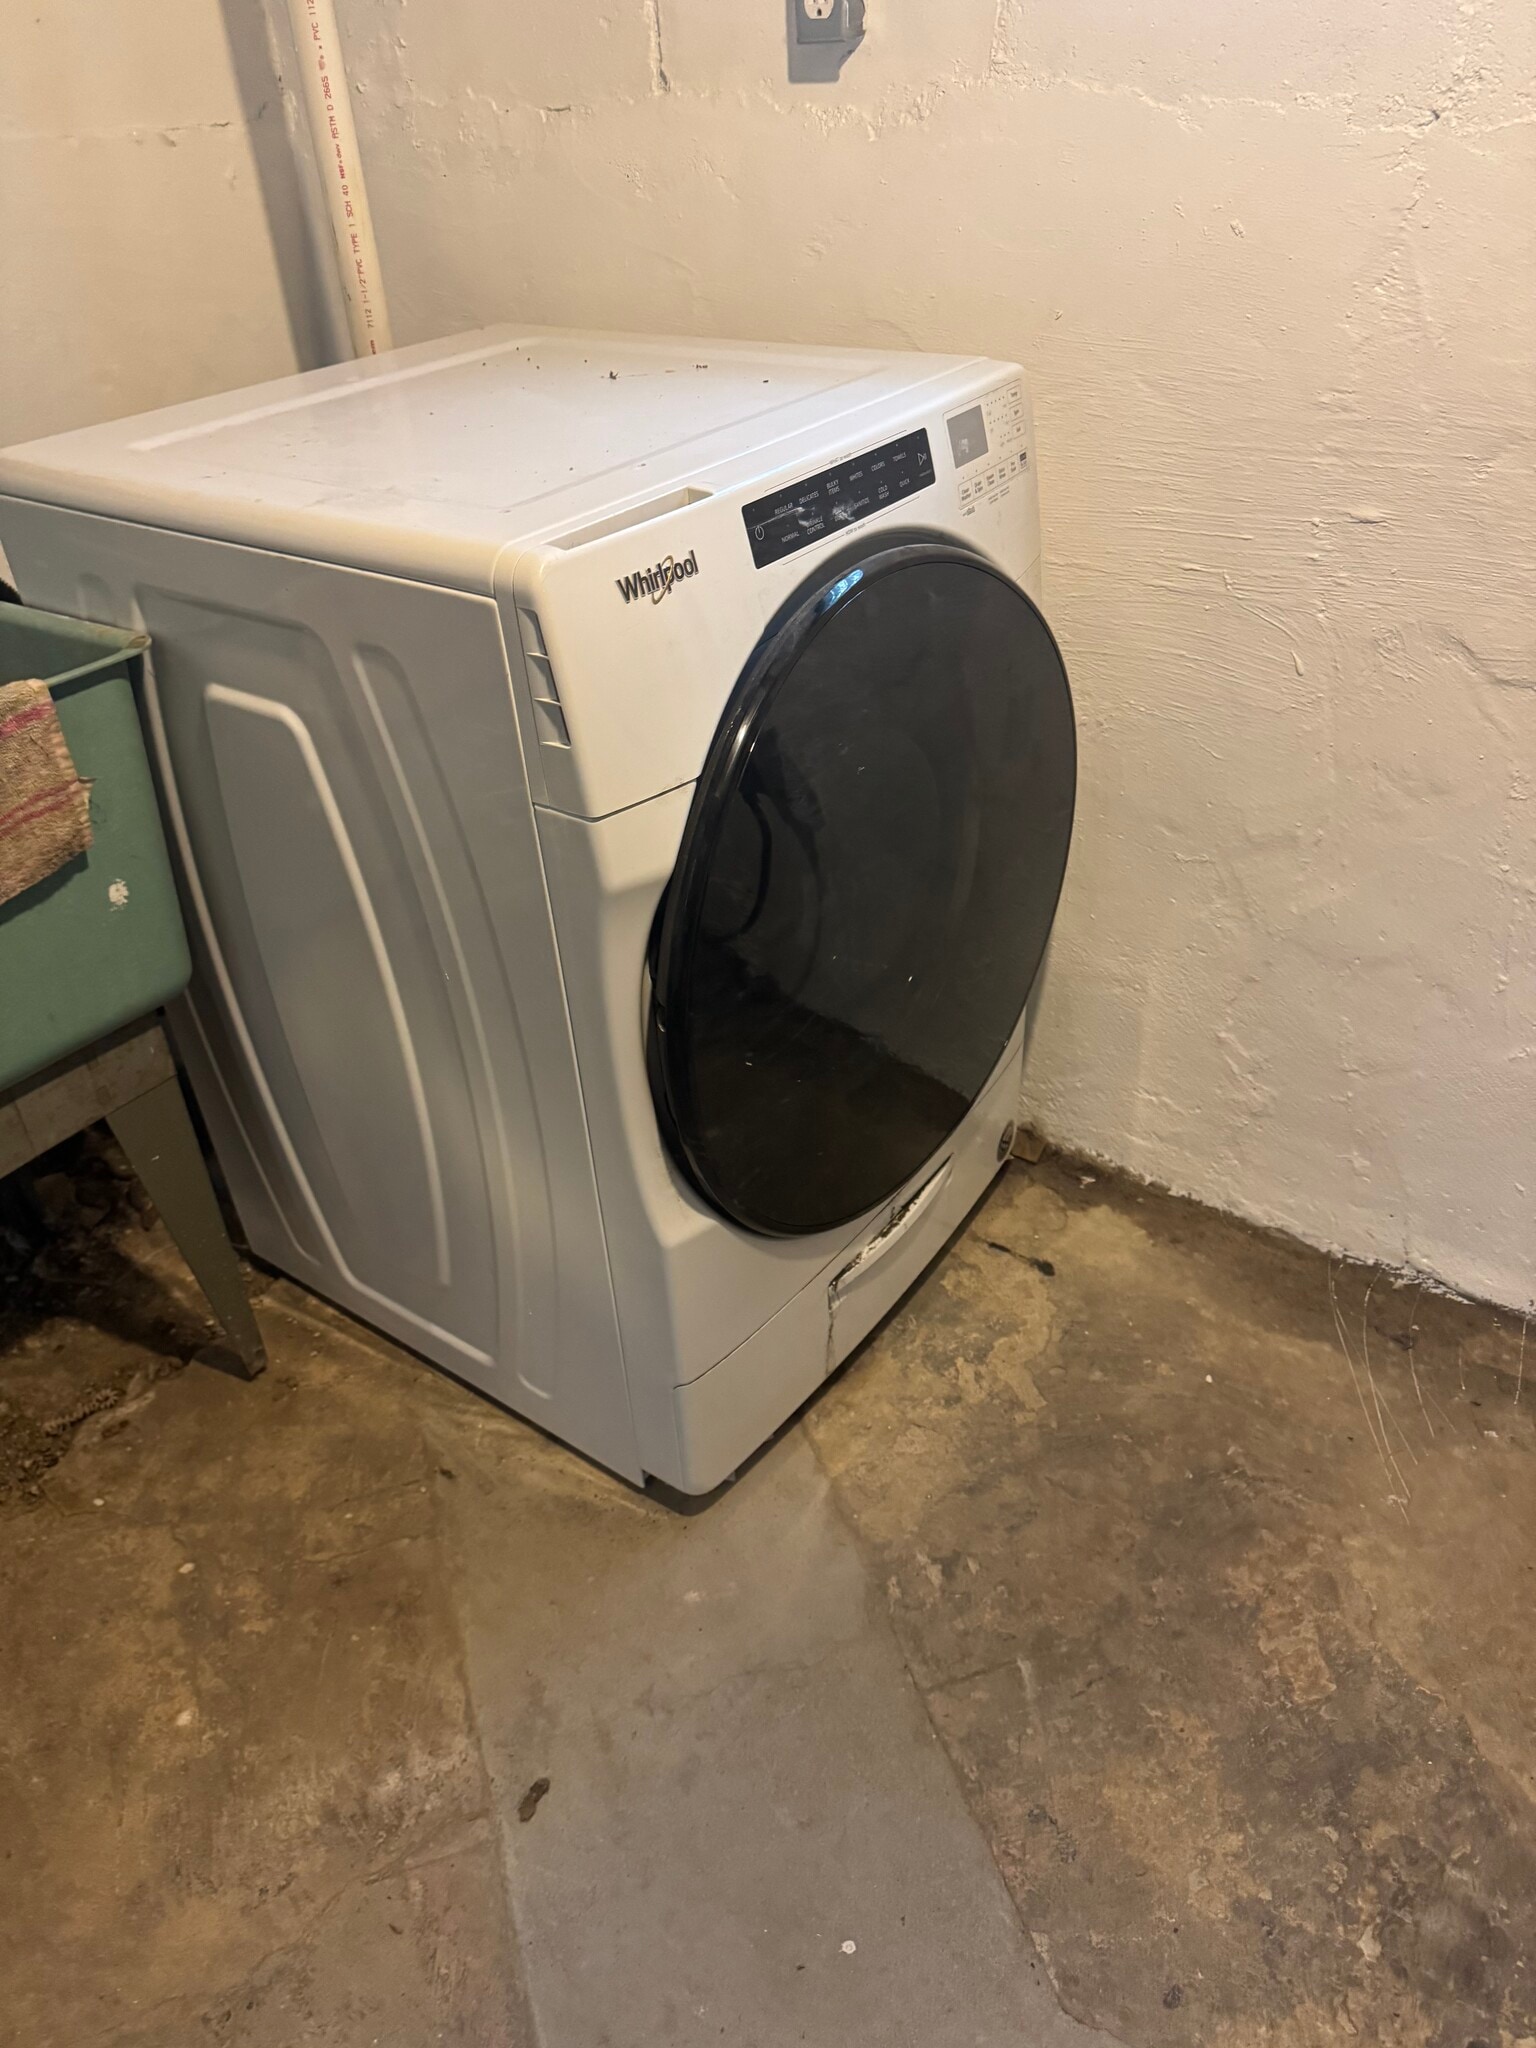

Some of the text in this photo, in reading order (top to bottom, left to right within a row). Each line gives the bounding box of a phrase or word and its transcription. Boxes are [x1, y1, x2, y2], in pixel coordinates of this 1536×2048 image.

[311, 22, 321, 41] PVC
[321, 75, 332, 99] 2665
[328, 116, 339, 139] ASTM
[342, 185, 349, 196] 40
[345, 201, 354, 218] SCH
[351, 233, 360, 253] TYPE
[871, 461, 885, 471] COLORS
[849, 471, 863, 481] WHITES
[826, 479, 839, 489] BULKY
[878, 484, 888, 494] COLD
[899, 478, 910, 488] QUICK
[828, 486, 840, 496] ITEMS
[878, 491, 890, 500] WASH
[798, 491, 819, 504] DELICATES
[774, 502, 793, 515] REGULAR
[806, 523, 825, 536] CONTROL
[781, 531, 799, 543] NORMAL
[615, 549, 699, 605] Whirlpool
